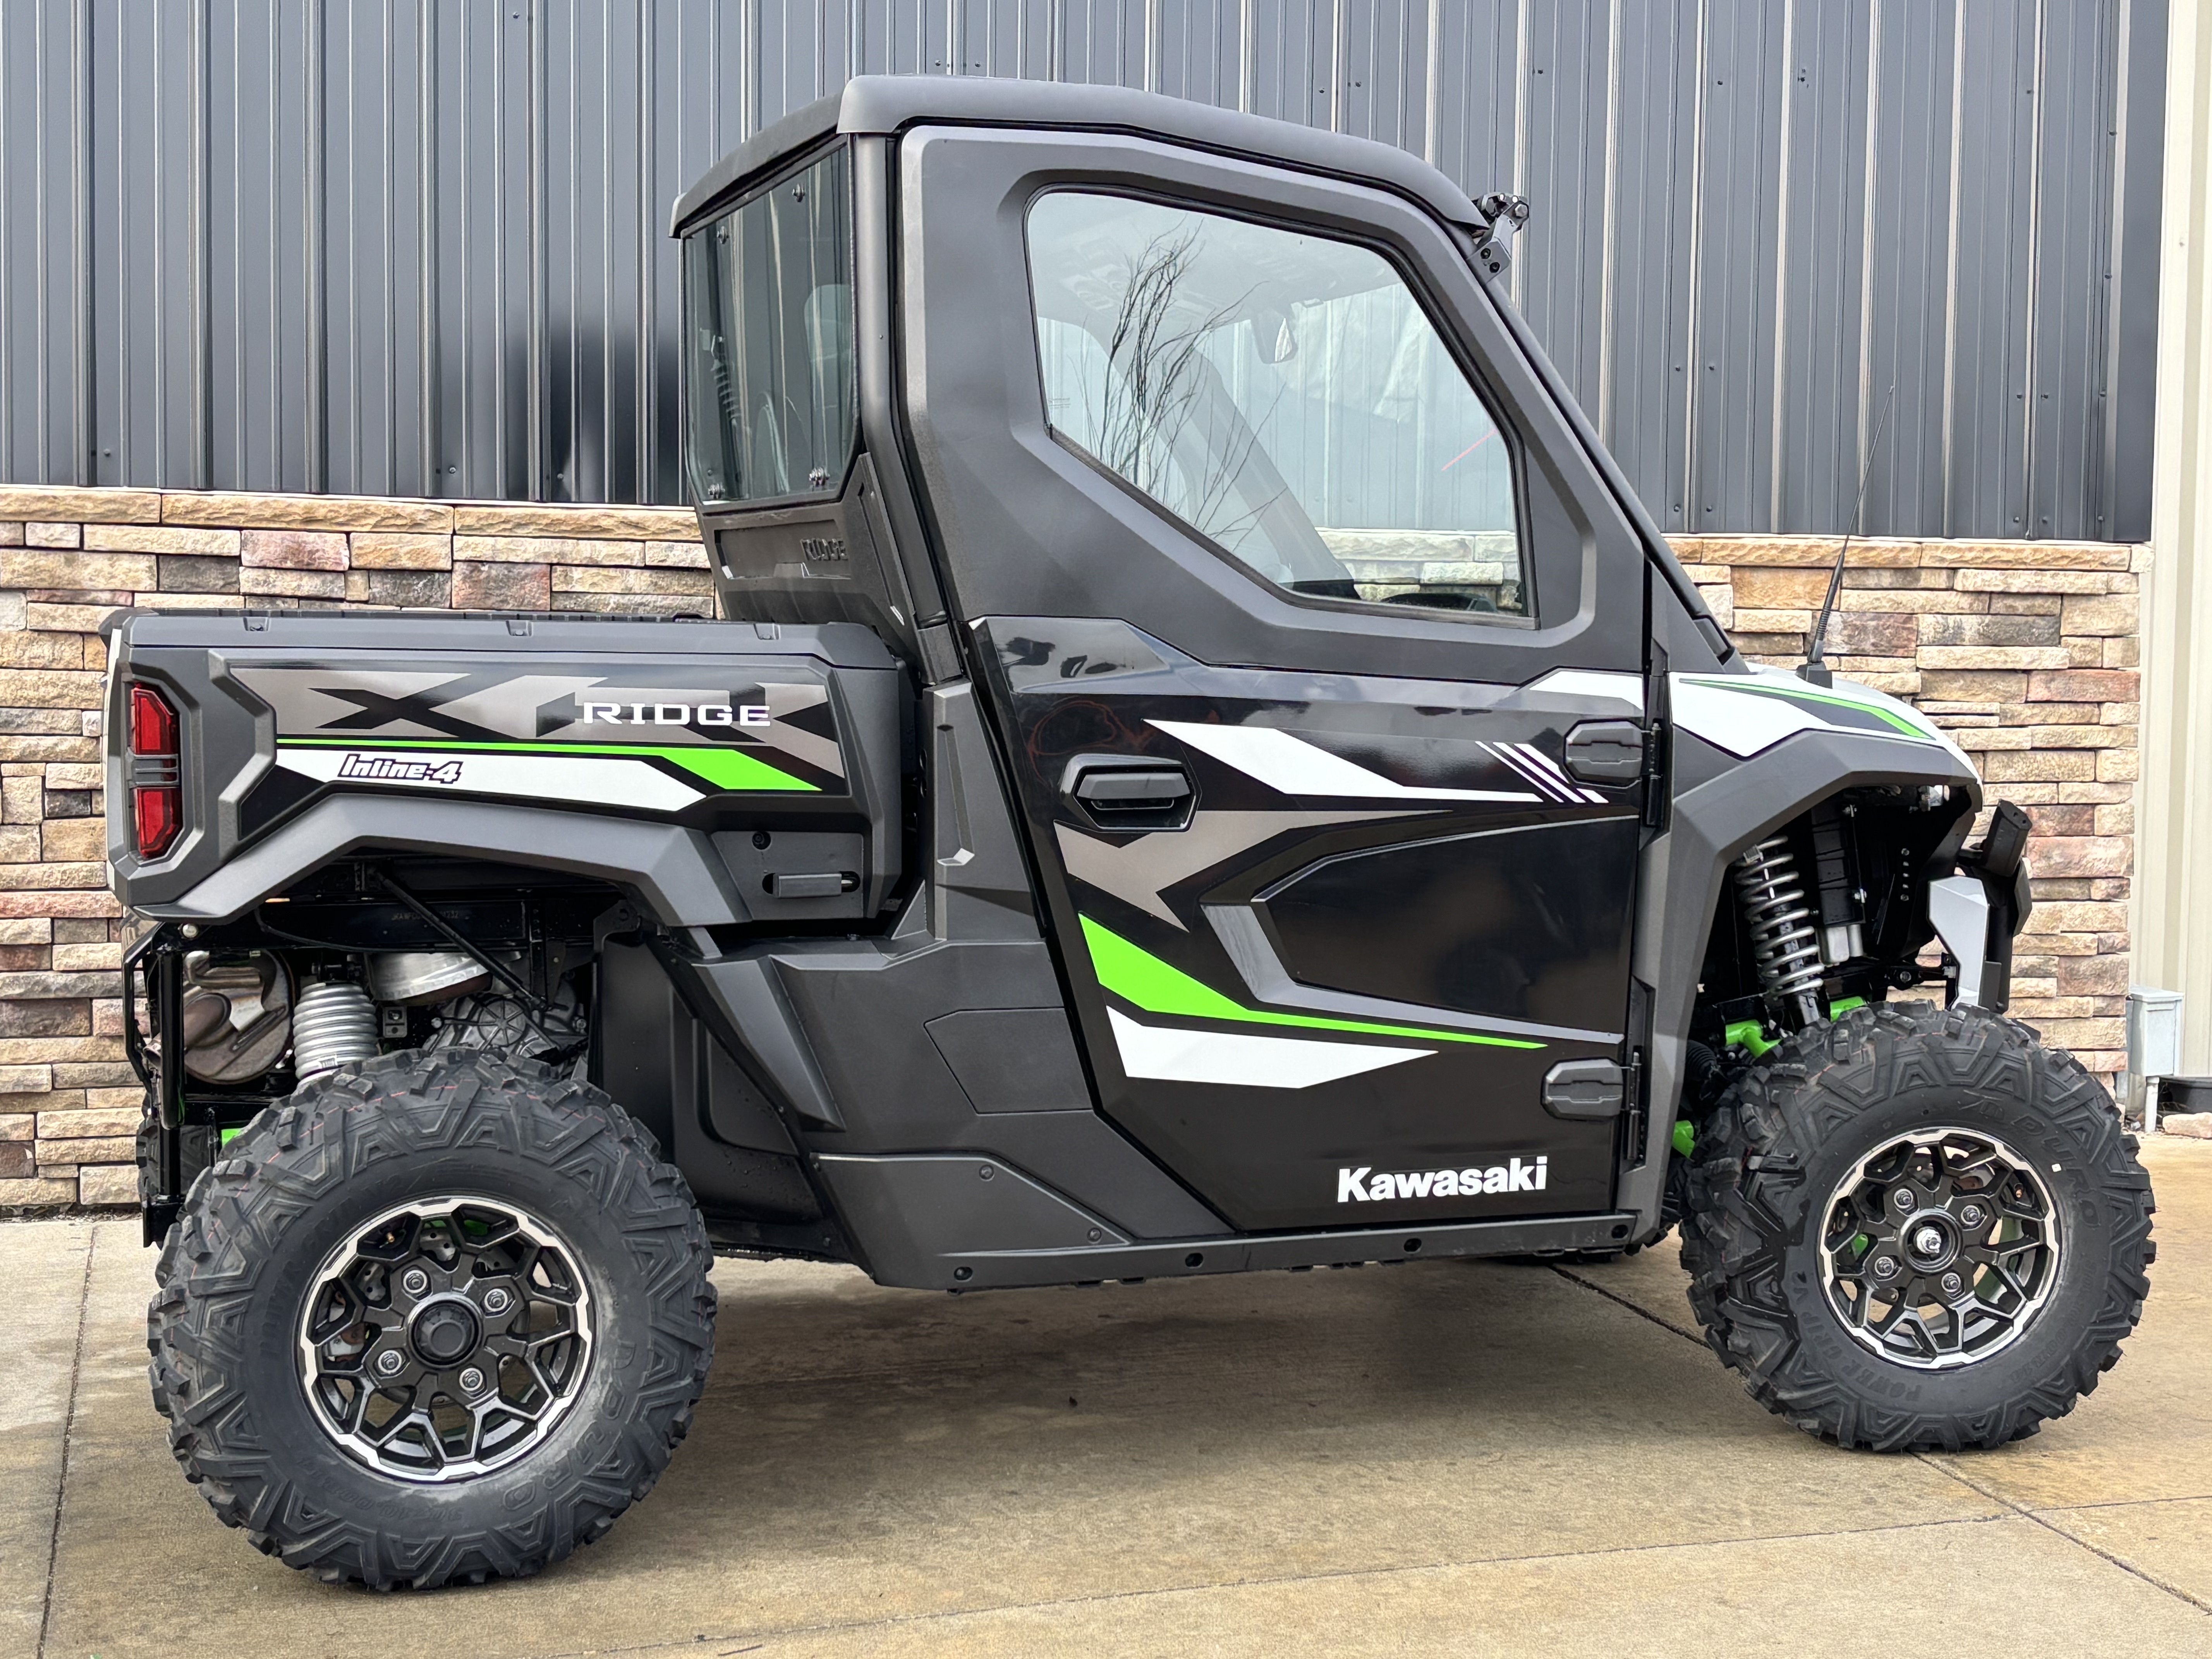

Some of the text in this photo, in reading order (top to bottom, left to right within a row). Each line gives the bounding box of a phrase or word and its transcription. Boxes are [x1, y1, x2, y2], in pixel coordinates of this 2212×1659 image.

[583, 702, 771, 726] RIDGE
[337, 754, 464, 784] Inline-4
[1337, 1156, 1547, 1202] Kawasaki
[2011, 1112, 2100, 1228] DURO
[1791, 1269, 1922, 1403] POWER GRIP V2
[503, 1382, 627, 1511] DURO
